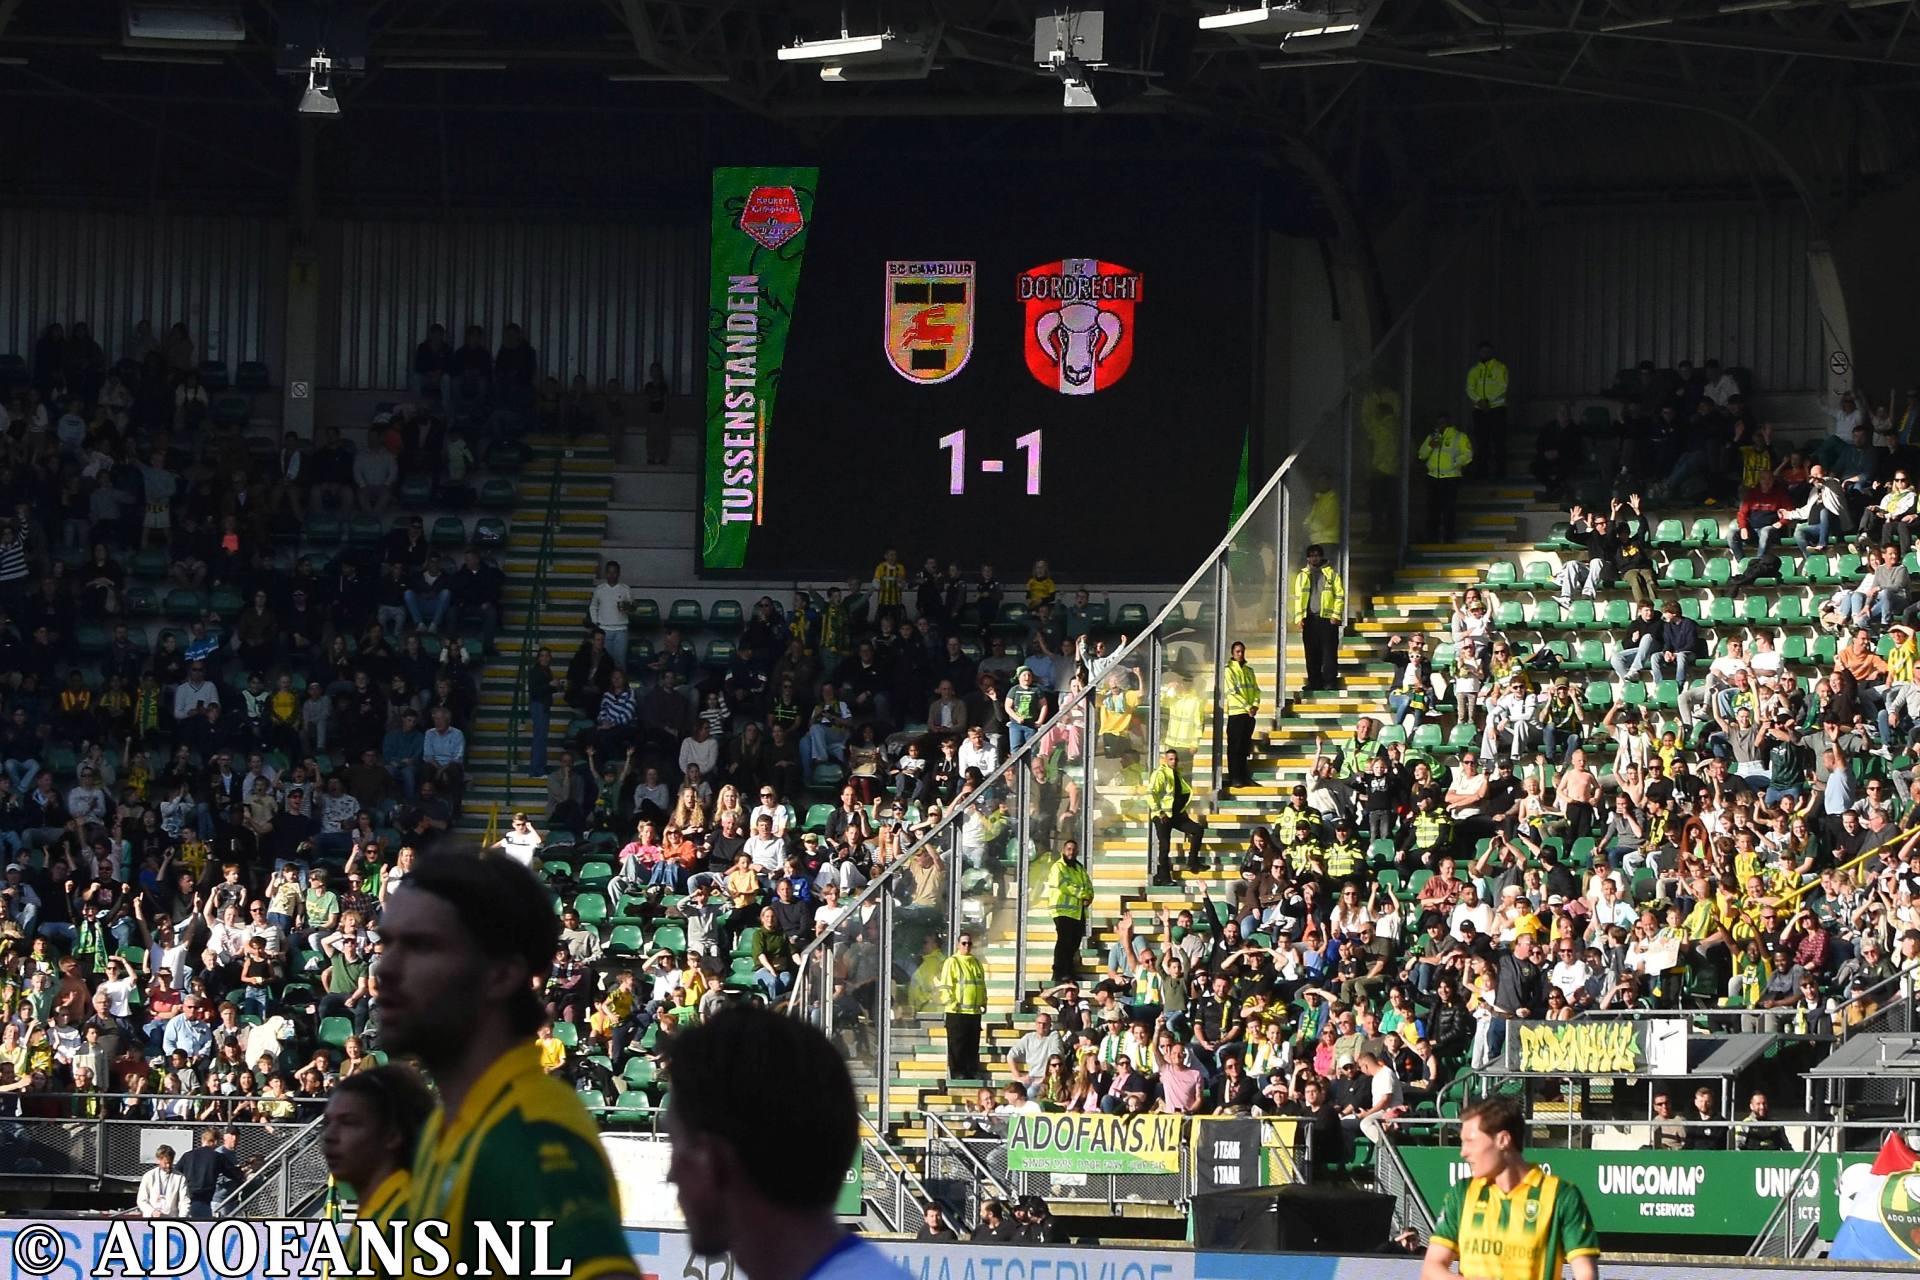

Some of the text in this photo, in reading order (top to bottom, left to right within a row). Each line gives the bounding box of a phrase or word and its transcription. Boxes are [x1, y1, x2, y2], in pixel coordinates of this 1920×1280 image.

[889, 264, 972, 275] SC CAMBUUR
[1020, 276, 1138, 298] DORDRECHT
[721, 274, 760, 525] TUSSENSTANDEN
[1010, 1115, 1177, 1153] ADOFANS.NL
[1598, 1165, 1696, 1196] UNICOMM
[1640, 1202, 1695, 1217] ICT SERVICES
[1887, 1214, 1905, 1222] ADO
